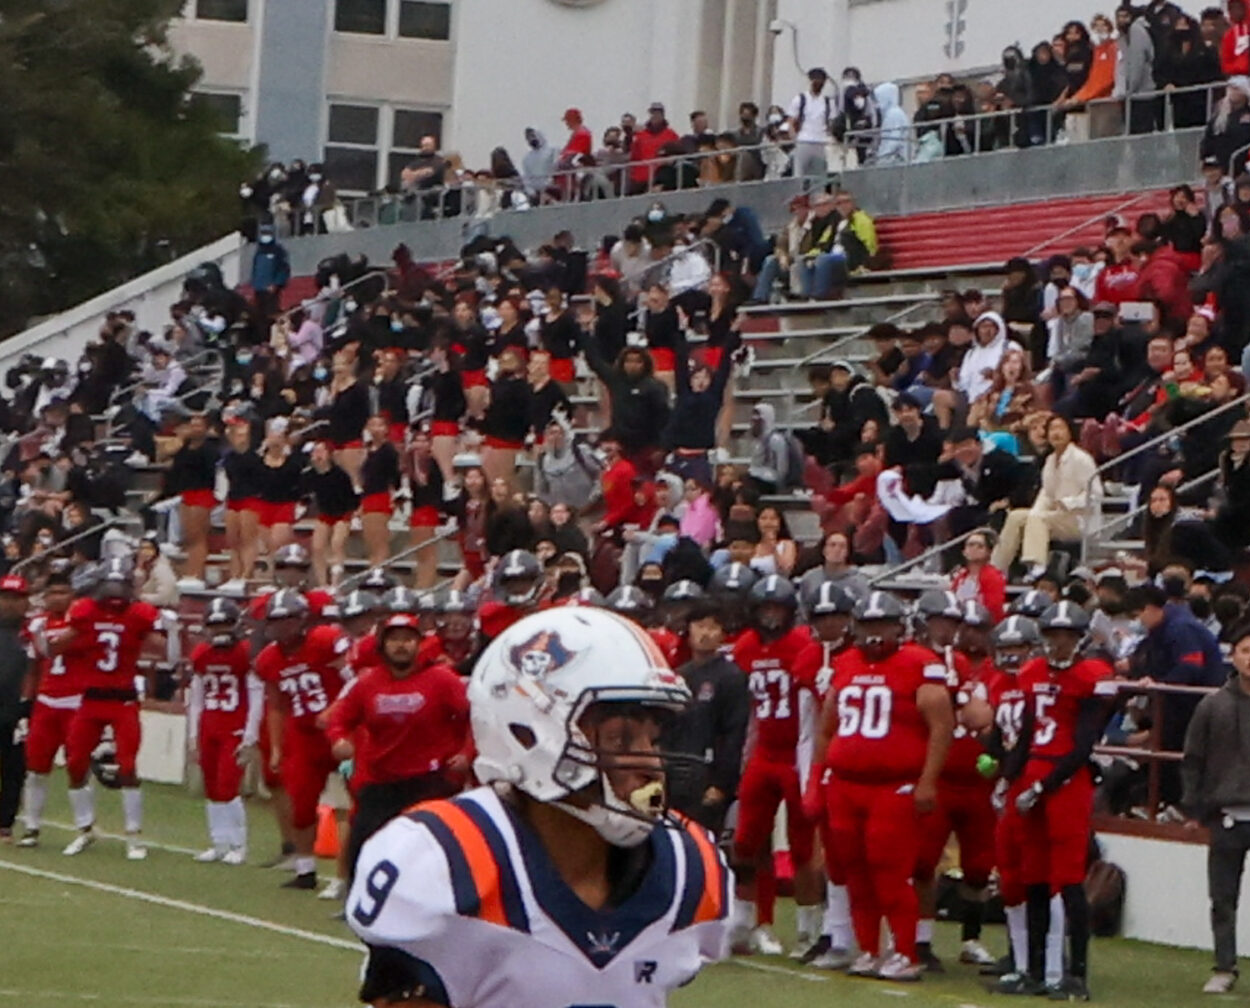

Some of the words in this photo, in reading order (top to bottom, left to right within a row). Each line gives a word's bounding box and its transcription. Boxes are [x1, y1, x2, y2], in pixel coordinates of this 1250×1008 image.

[96, 631, 120, 672] 3
[201, 674, 239, 712] 23
[748, 669, 791, 719] 97
[837, 685, 892, 739] 60
[1034, 693, 1057, 745] 5
[353, 859, 399, 928] 9
